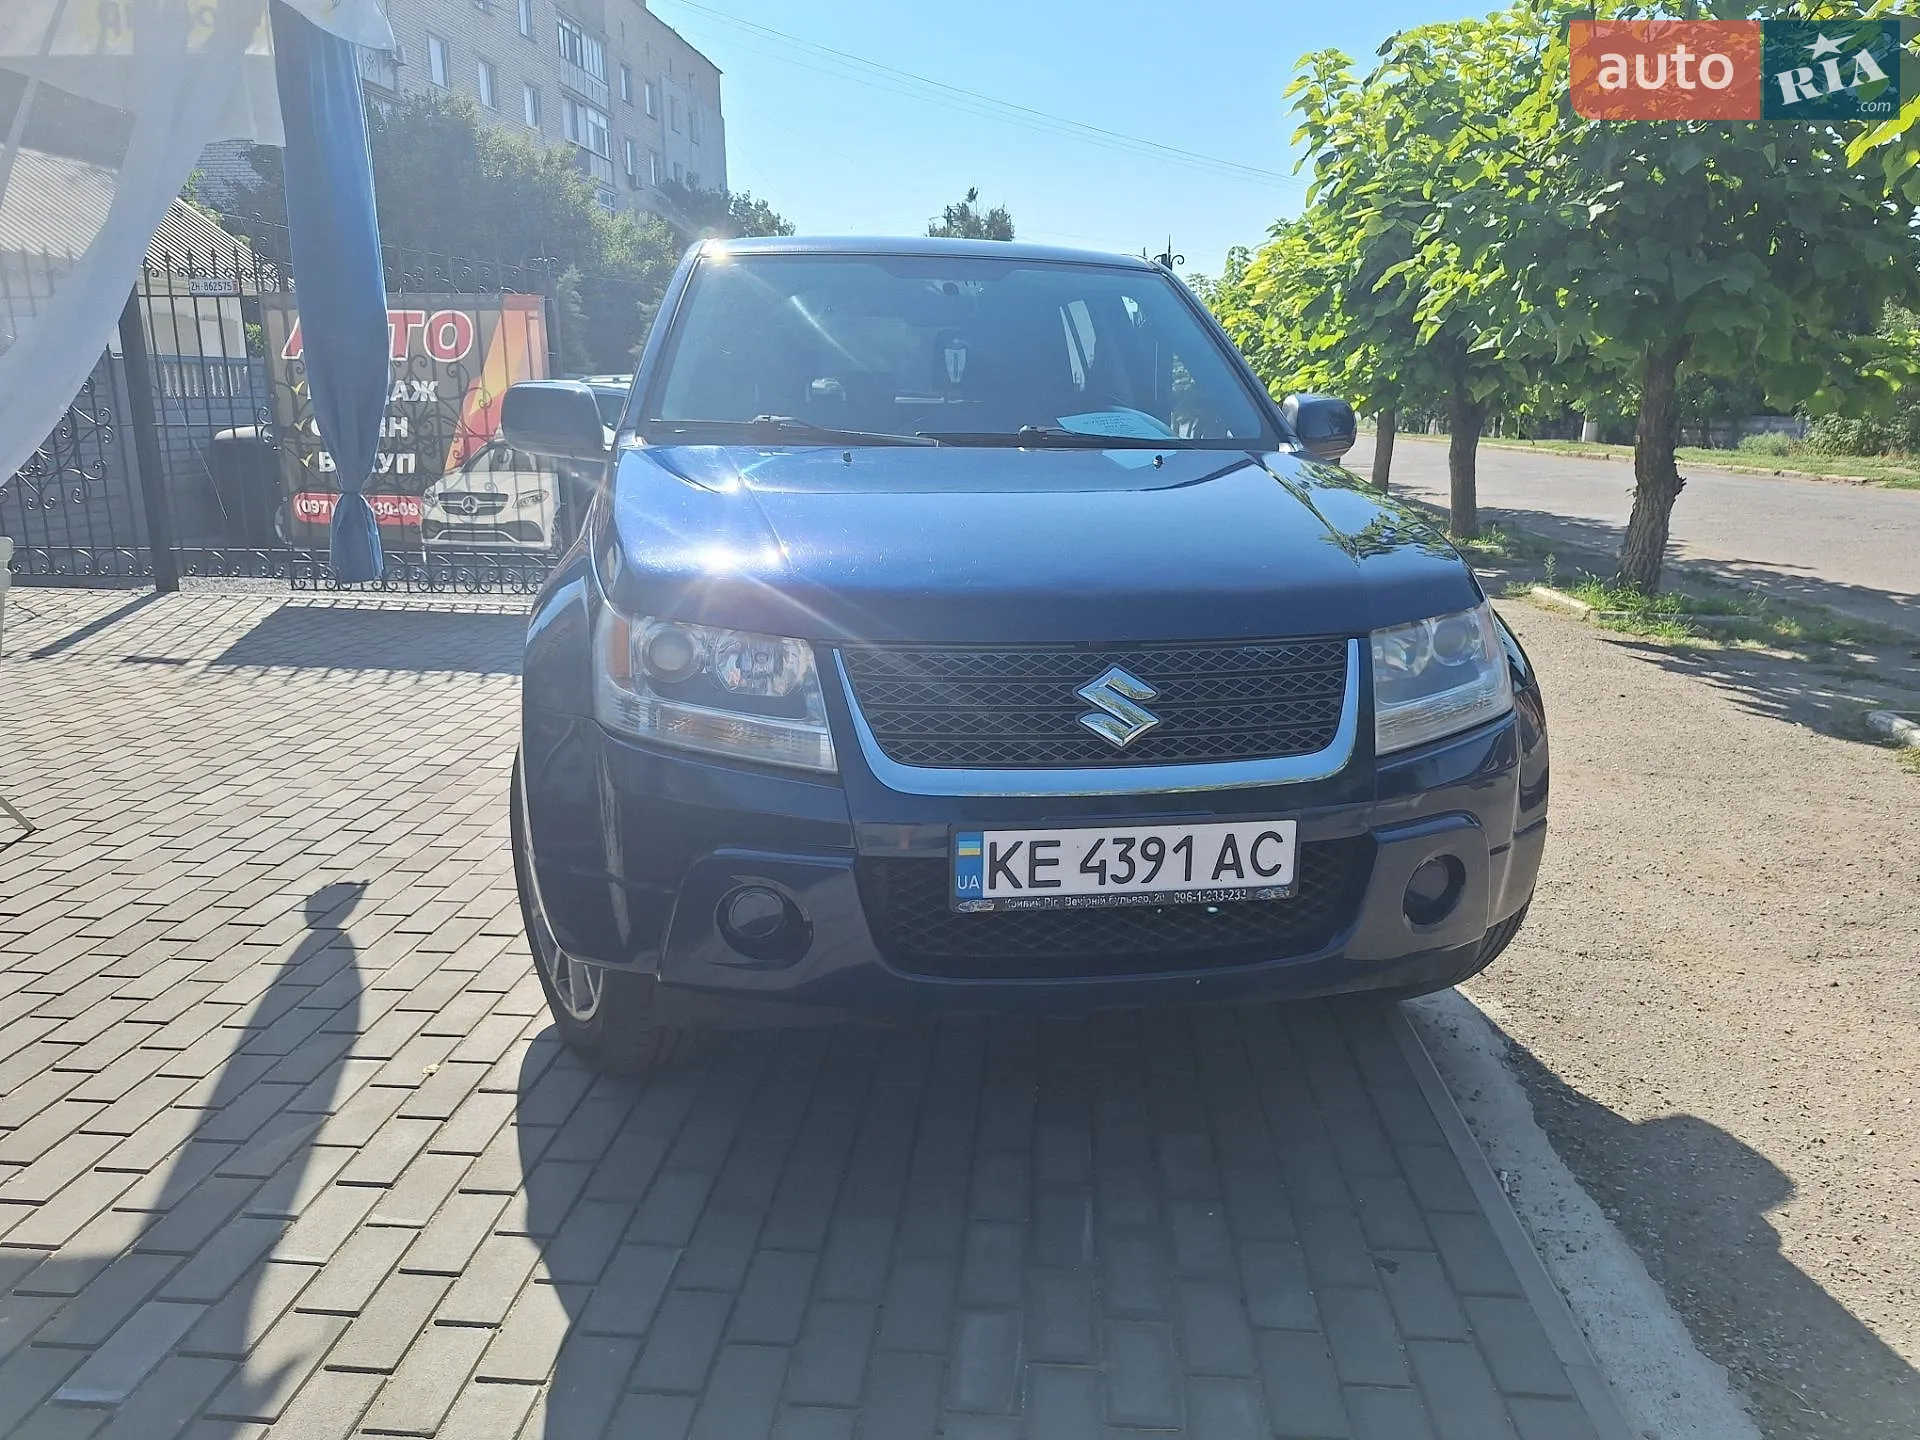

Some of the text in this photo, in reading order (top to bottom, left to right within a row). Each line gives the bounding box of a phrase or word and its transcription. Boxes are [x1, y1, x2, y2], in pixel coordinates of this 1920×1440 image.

[1079, 834, 1194, 886] 4391
[957, 875, 980, 890] UA
[1173, 888, 1248, 904] 096-1-233-233
